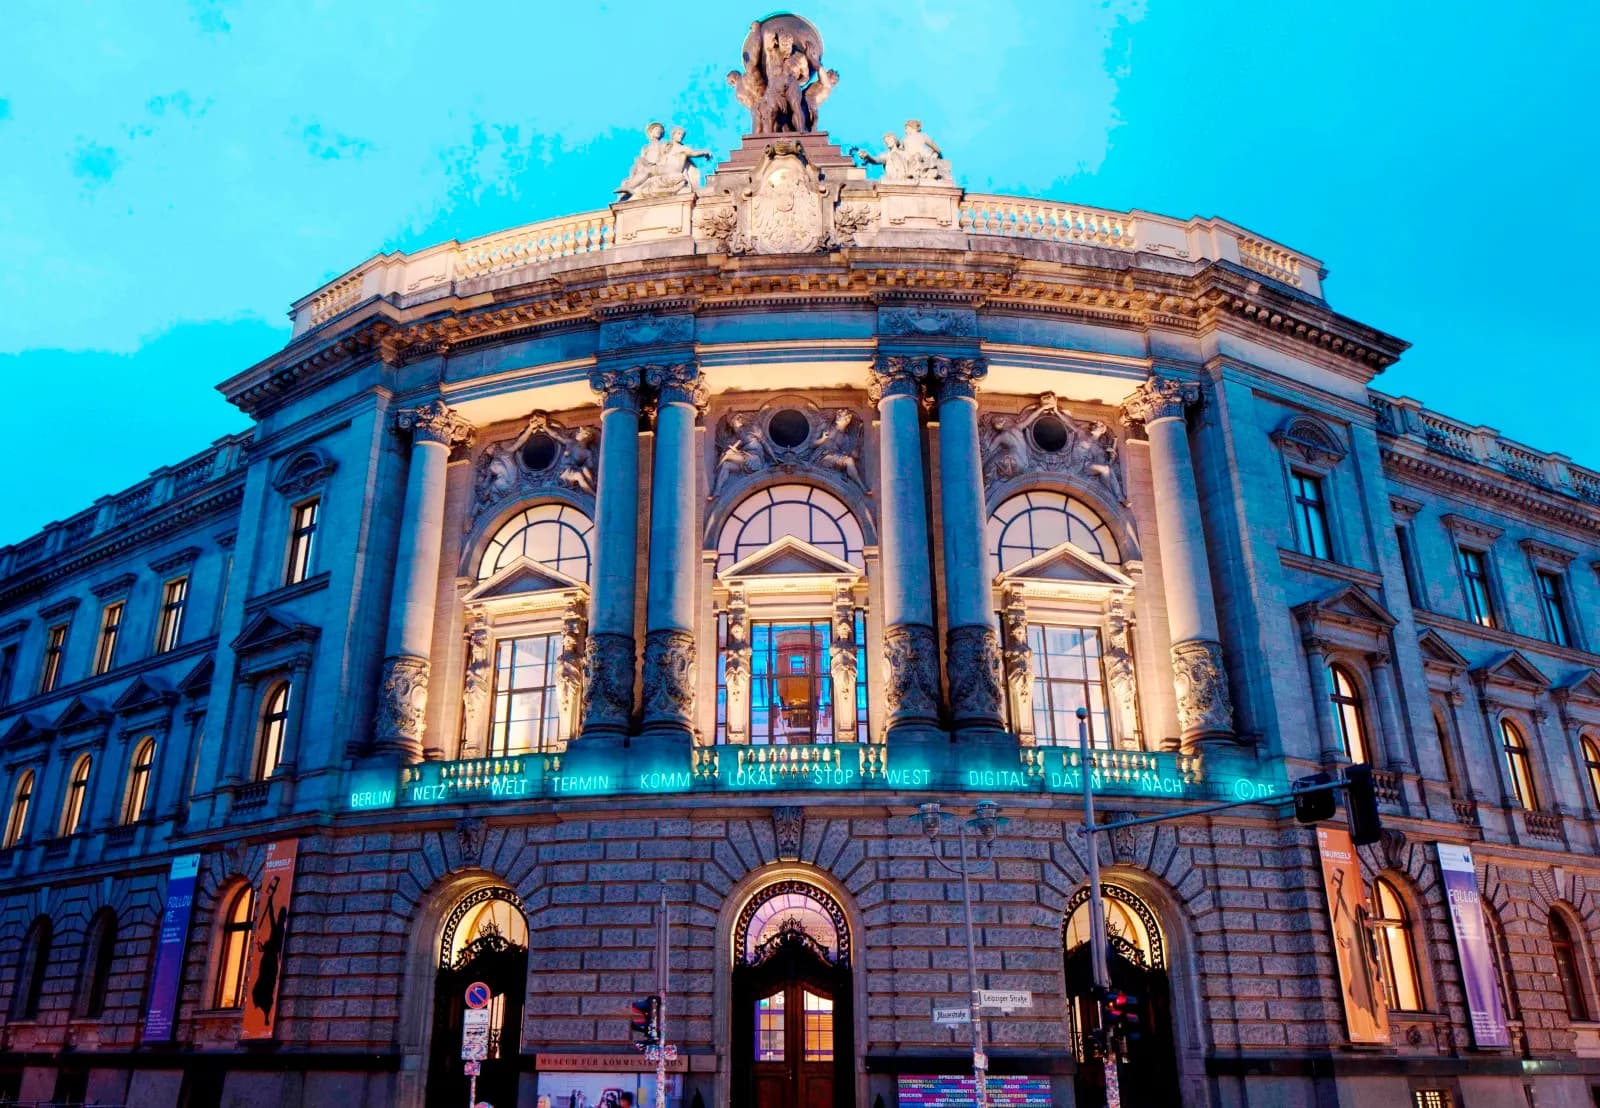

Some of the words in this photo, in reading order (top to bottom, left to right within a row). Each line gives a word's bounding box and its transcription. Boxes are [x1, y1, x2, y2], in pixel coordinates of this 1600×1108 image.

[351, 790, 391, 807] BERLIN
[413, 783, 446, 801] NETZ
[491, 777, 528, 796] WELT
[552, 775, 609, 792] TERMIN
[640, 772, 690, 789] KOMM
[728, 771, 776, 786] LOKAL
[814, 769, 854, 785] STOP
[885, 769, 931, 785] WEST
[969, 770, 1028, 787] DIGITAL
[1051, 772, 1101, 789] DATN
[1141, 776, 1182, 793] NACH
[983, 993, 1008, 1004] Leipziger
[540, 1057, 577, 1066] MUSEUM
